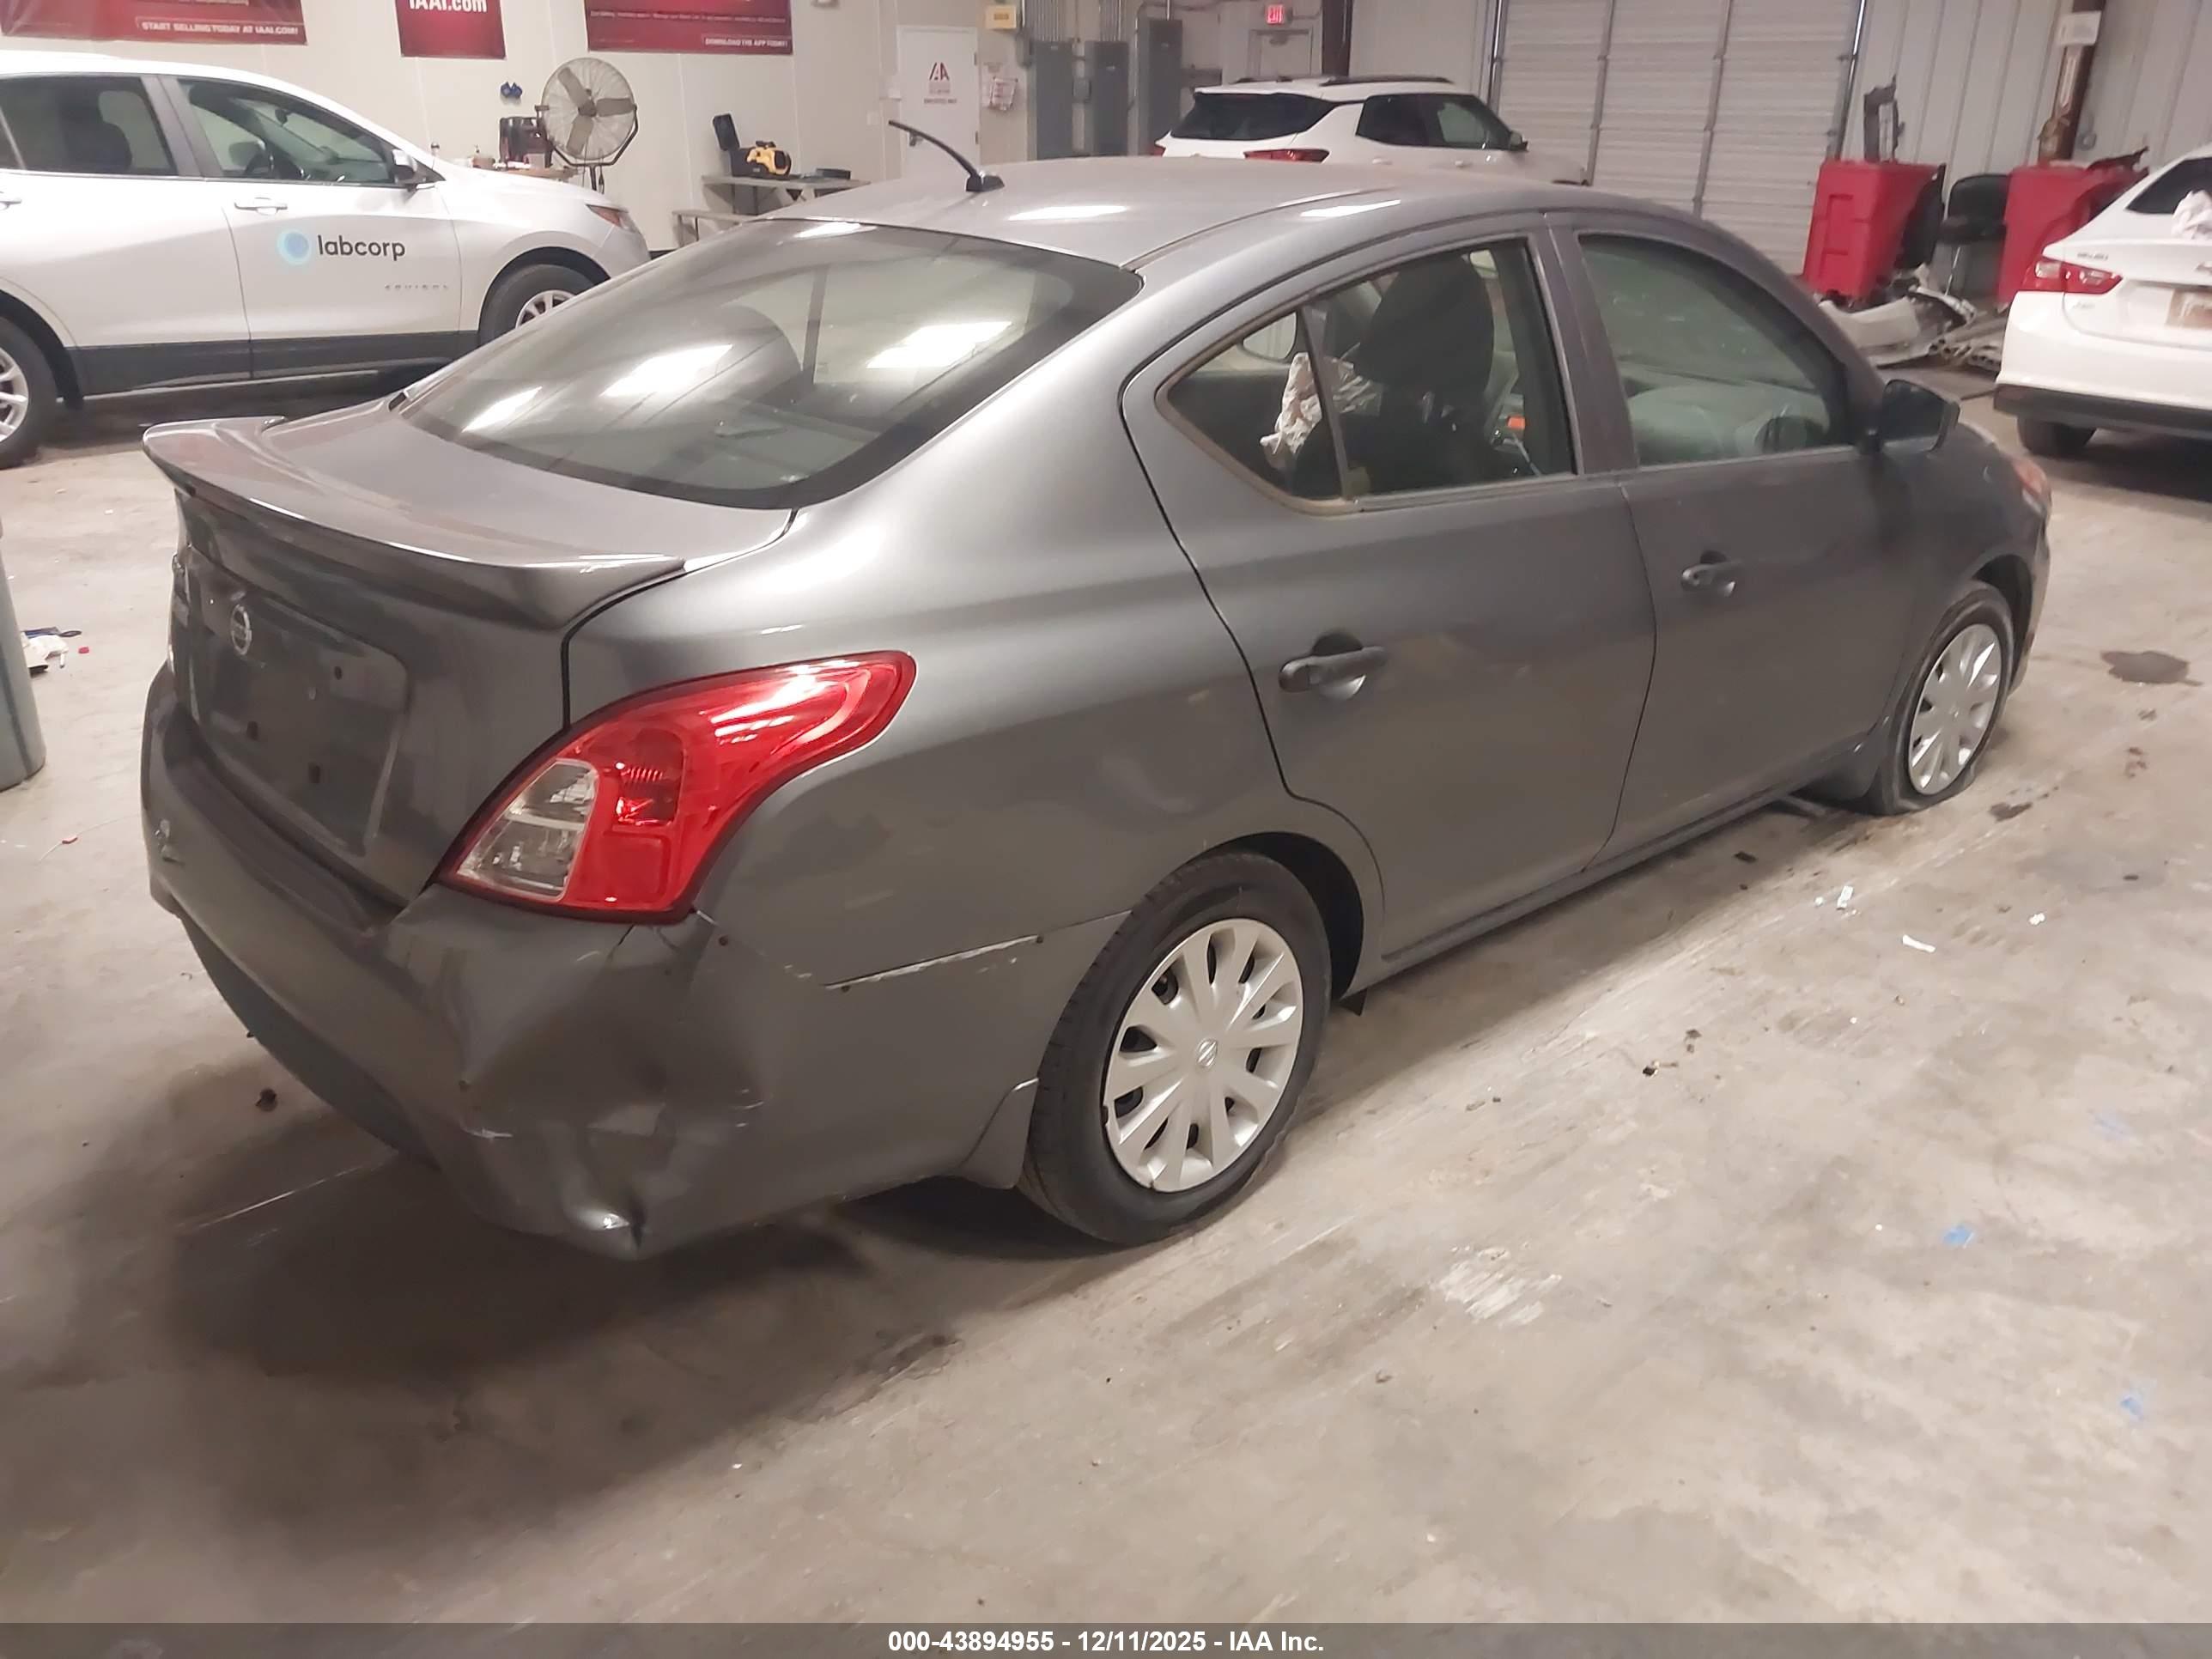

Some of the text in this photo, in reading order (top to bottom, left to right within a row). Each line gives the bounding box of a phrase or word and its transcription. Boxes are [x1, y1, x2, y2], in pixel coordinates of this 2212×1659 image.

[409, 0, 487, 12] IAAI.com
[142, 21, 171, 31] START
[173, 23, 211, 33] SELLING
[212, 24, 240, 33] TODAY
[318, 234, 405, 262] labcorp
